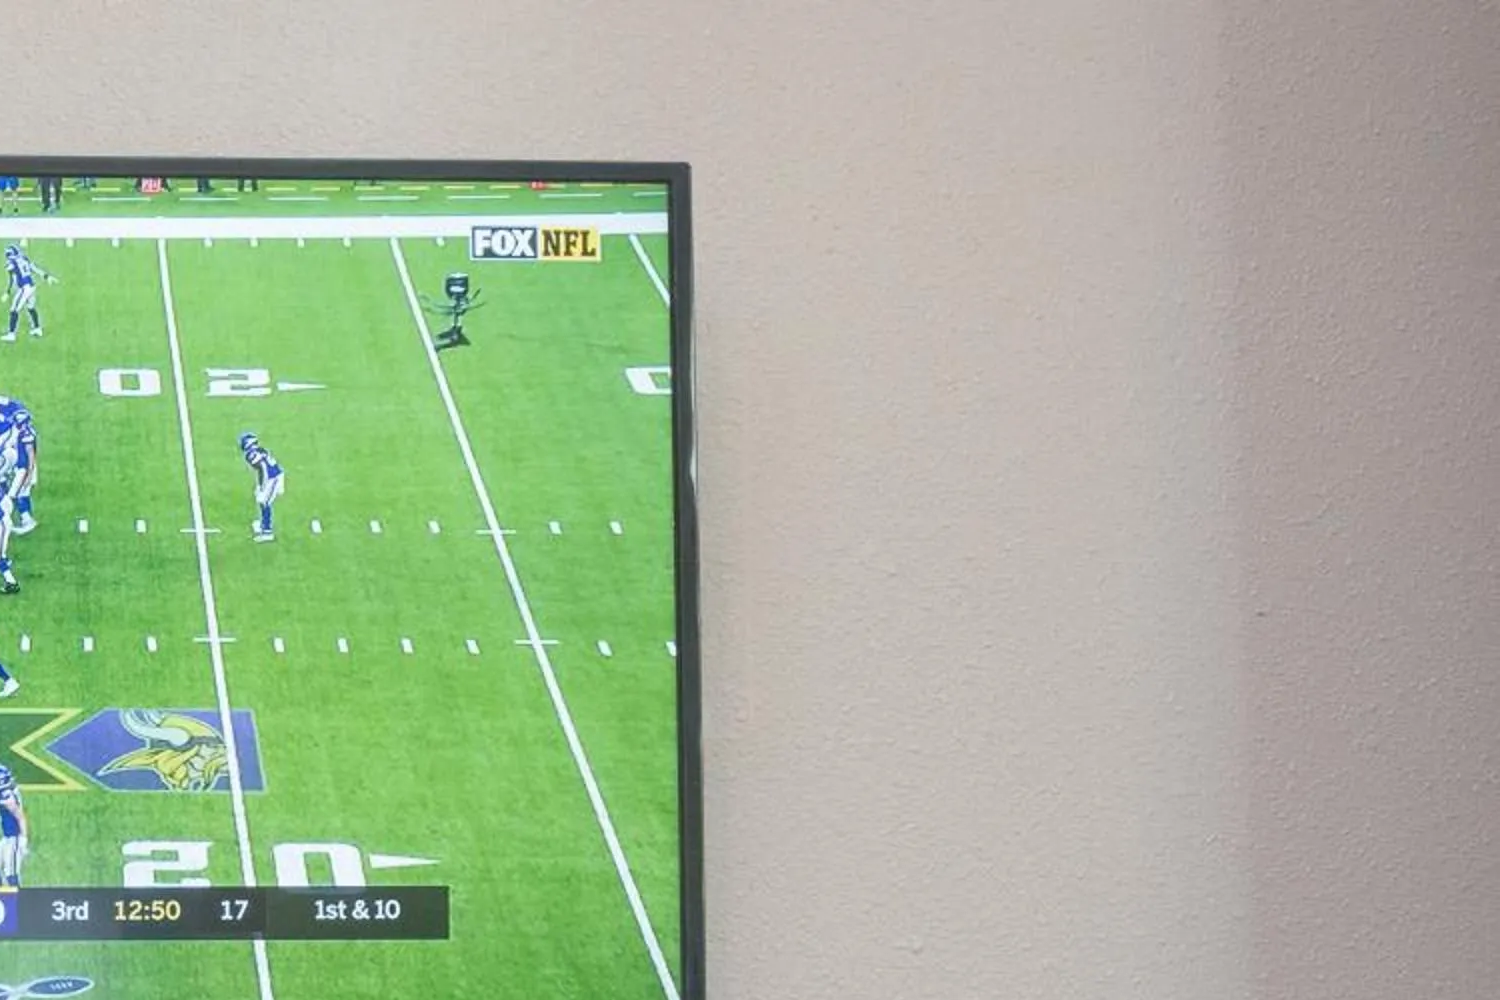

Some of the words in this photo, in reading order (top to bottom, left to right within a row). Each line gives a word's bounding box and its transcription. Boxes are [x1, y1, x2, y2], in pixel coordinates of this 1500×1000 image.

[474, 229, 535, 257] FOX
[542, 229, 597, 257] NFL
[51, 901, 89, 921] 3rd
[114, 900, 181, 921] 12:50
[220, 901, 249, 920] 17
[314, 900, 347, 920] 1st
[351, 900, 371, 920] &
[374, 900, 401, 920] 10
